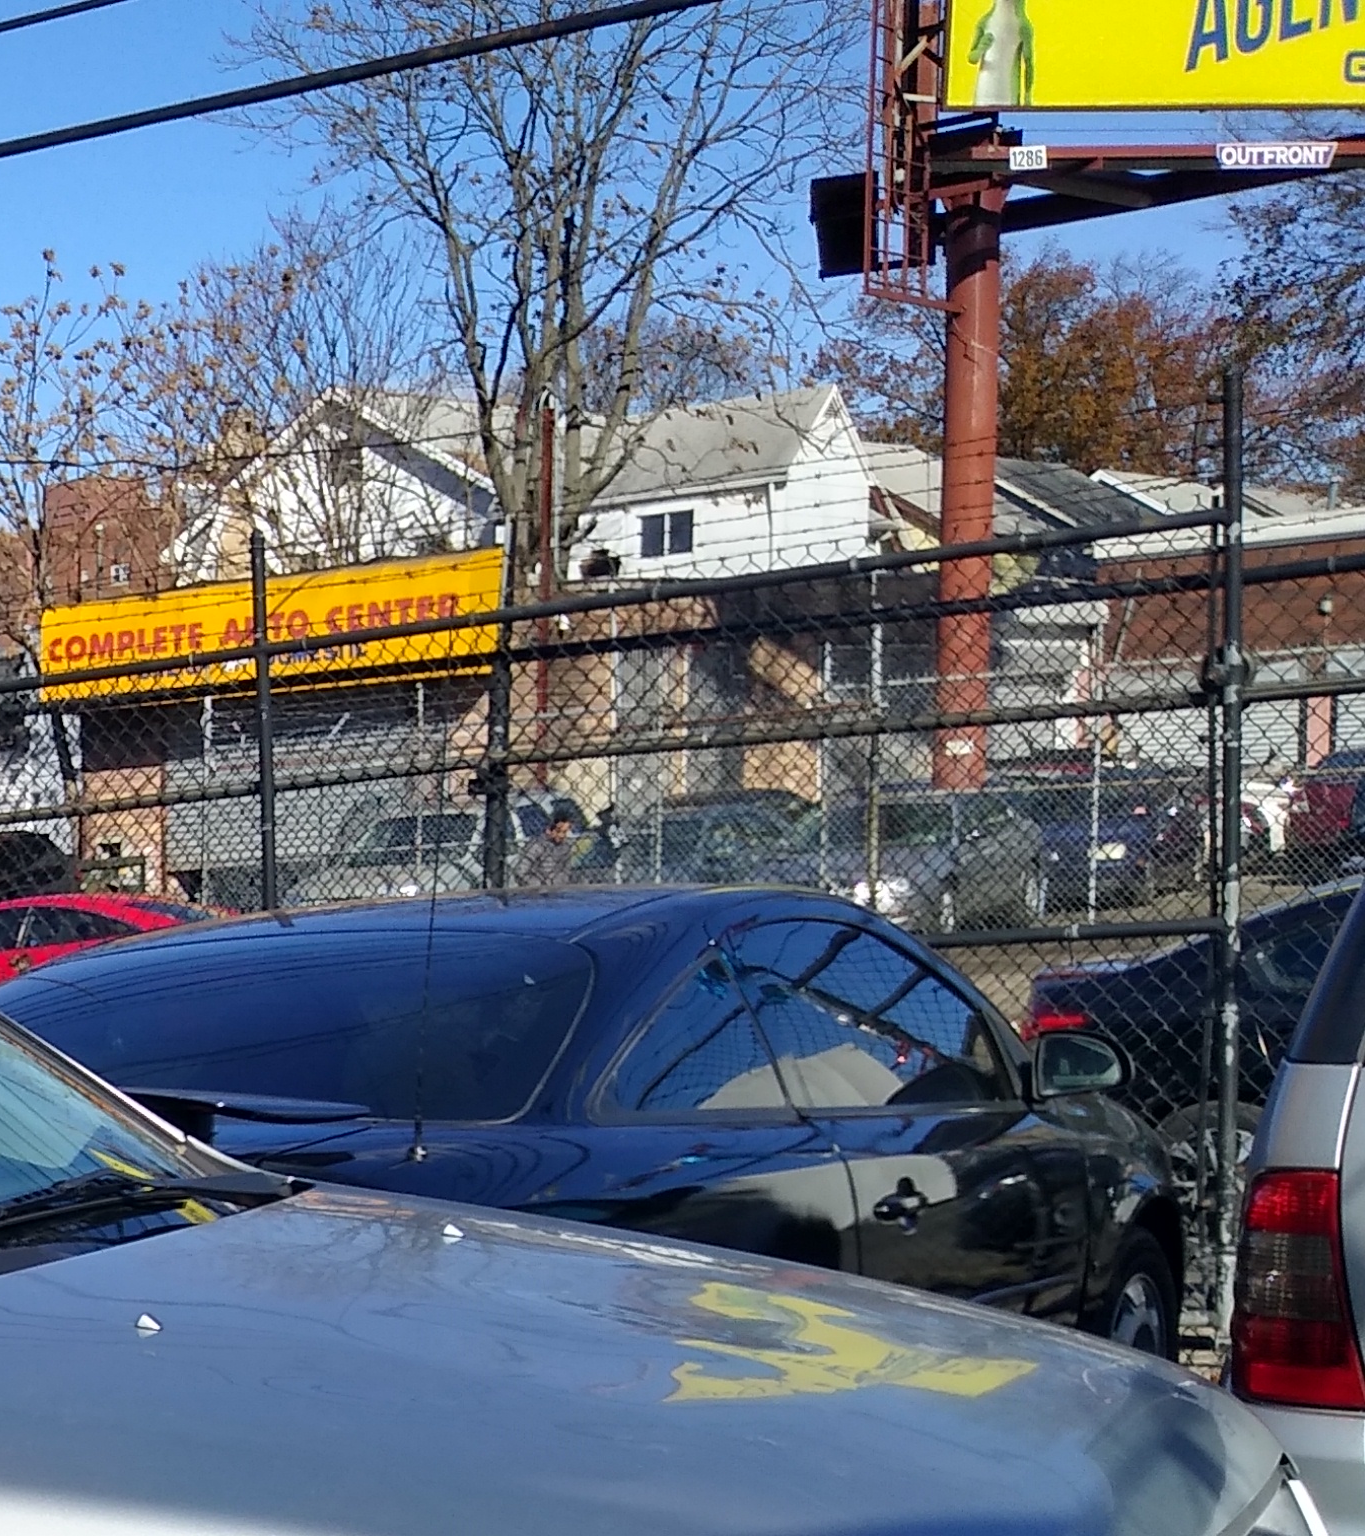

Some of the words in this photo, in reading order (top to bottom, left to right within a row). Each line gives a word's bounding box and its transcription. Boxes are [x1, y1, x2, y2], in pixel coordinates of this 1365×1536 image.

[1185, 0, 1359, 72] AG
[1012, 149, 1043, 168] 1286
[1221, 145, 1329, 166] OUTFRONT
[48, 622, 204, 664] COMPLETE
[325, 592, 459, 637] CENTER
